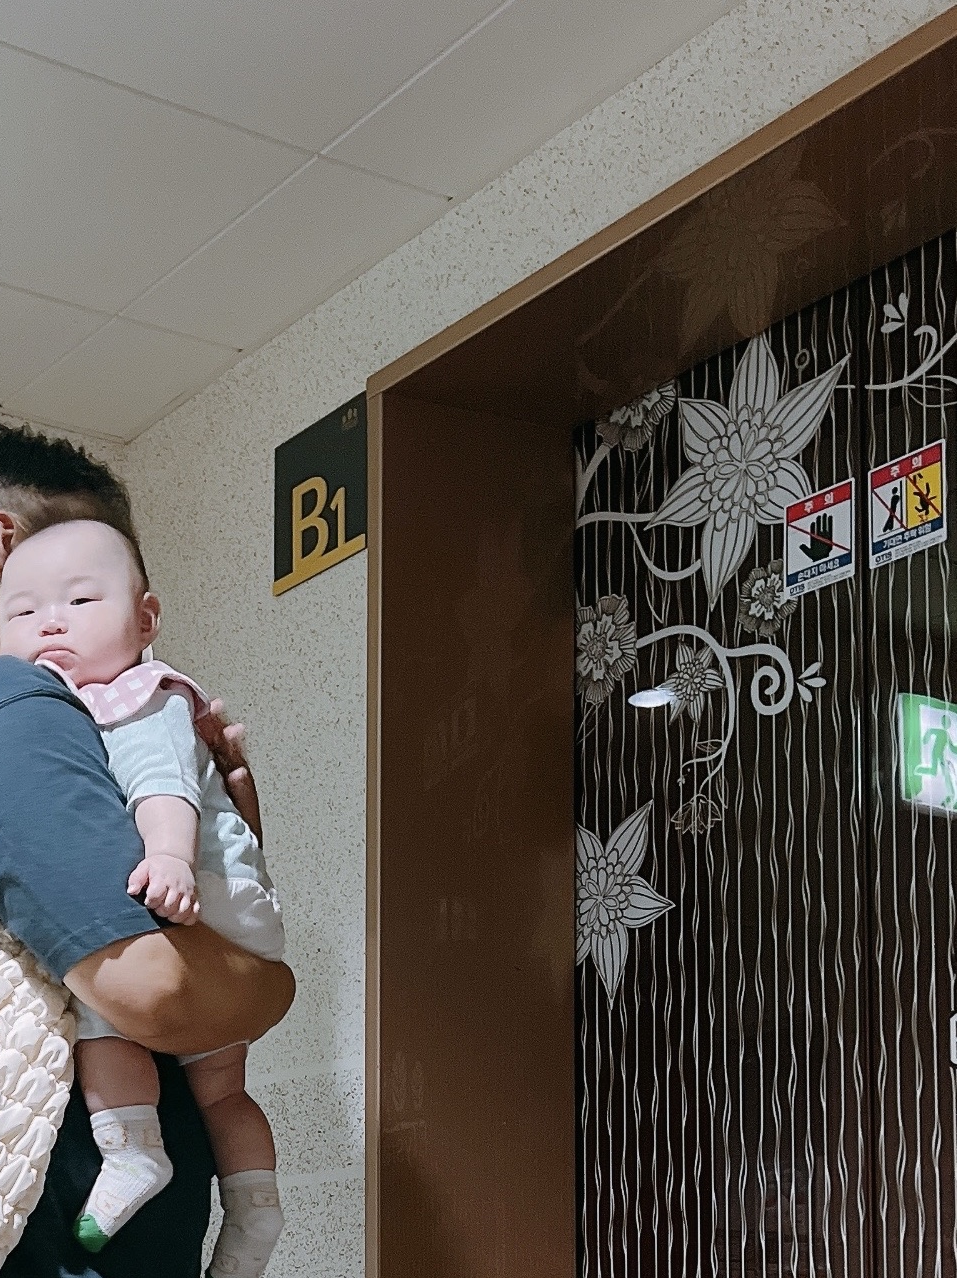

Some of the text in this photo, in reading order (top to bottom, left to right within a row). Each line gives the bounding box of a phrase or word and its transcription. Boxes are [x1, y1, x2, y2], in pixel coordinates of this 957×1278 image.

[292, 476, 346, 573] B1
[875, 551, 893, 564] OTIS
[797, 565, 819, 582] 손대지
[818, 558, 840, 573] 마세요
[789, 583, 805, 596] OTIS
